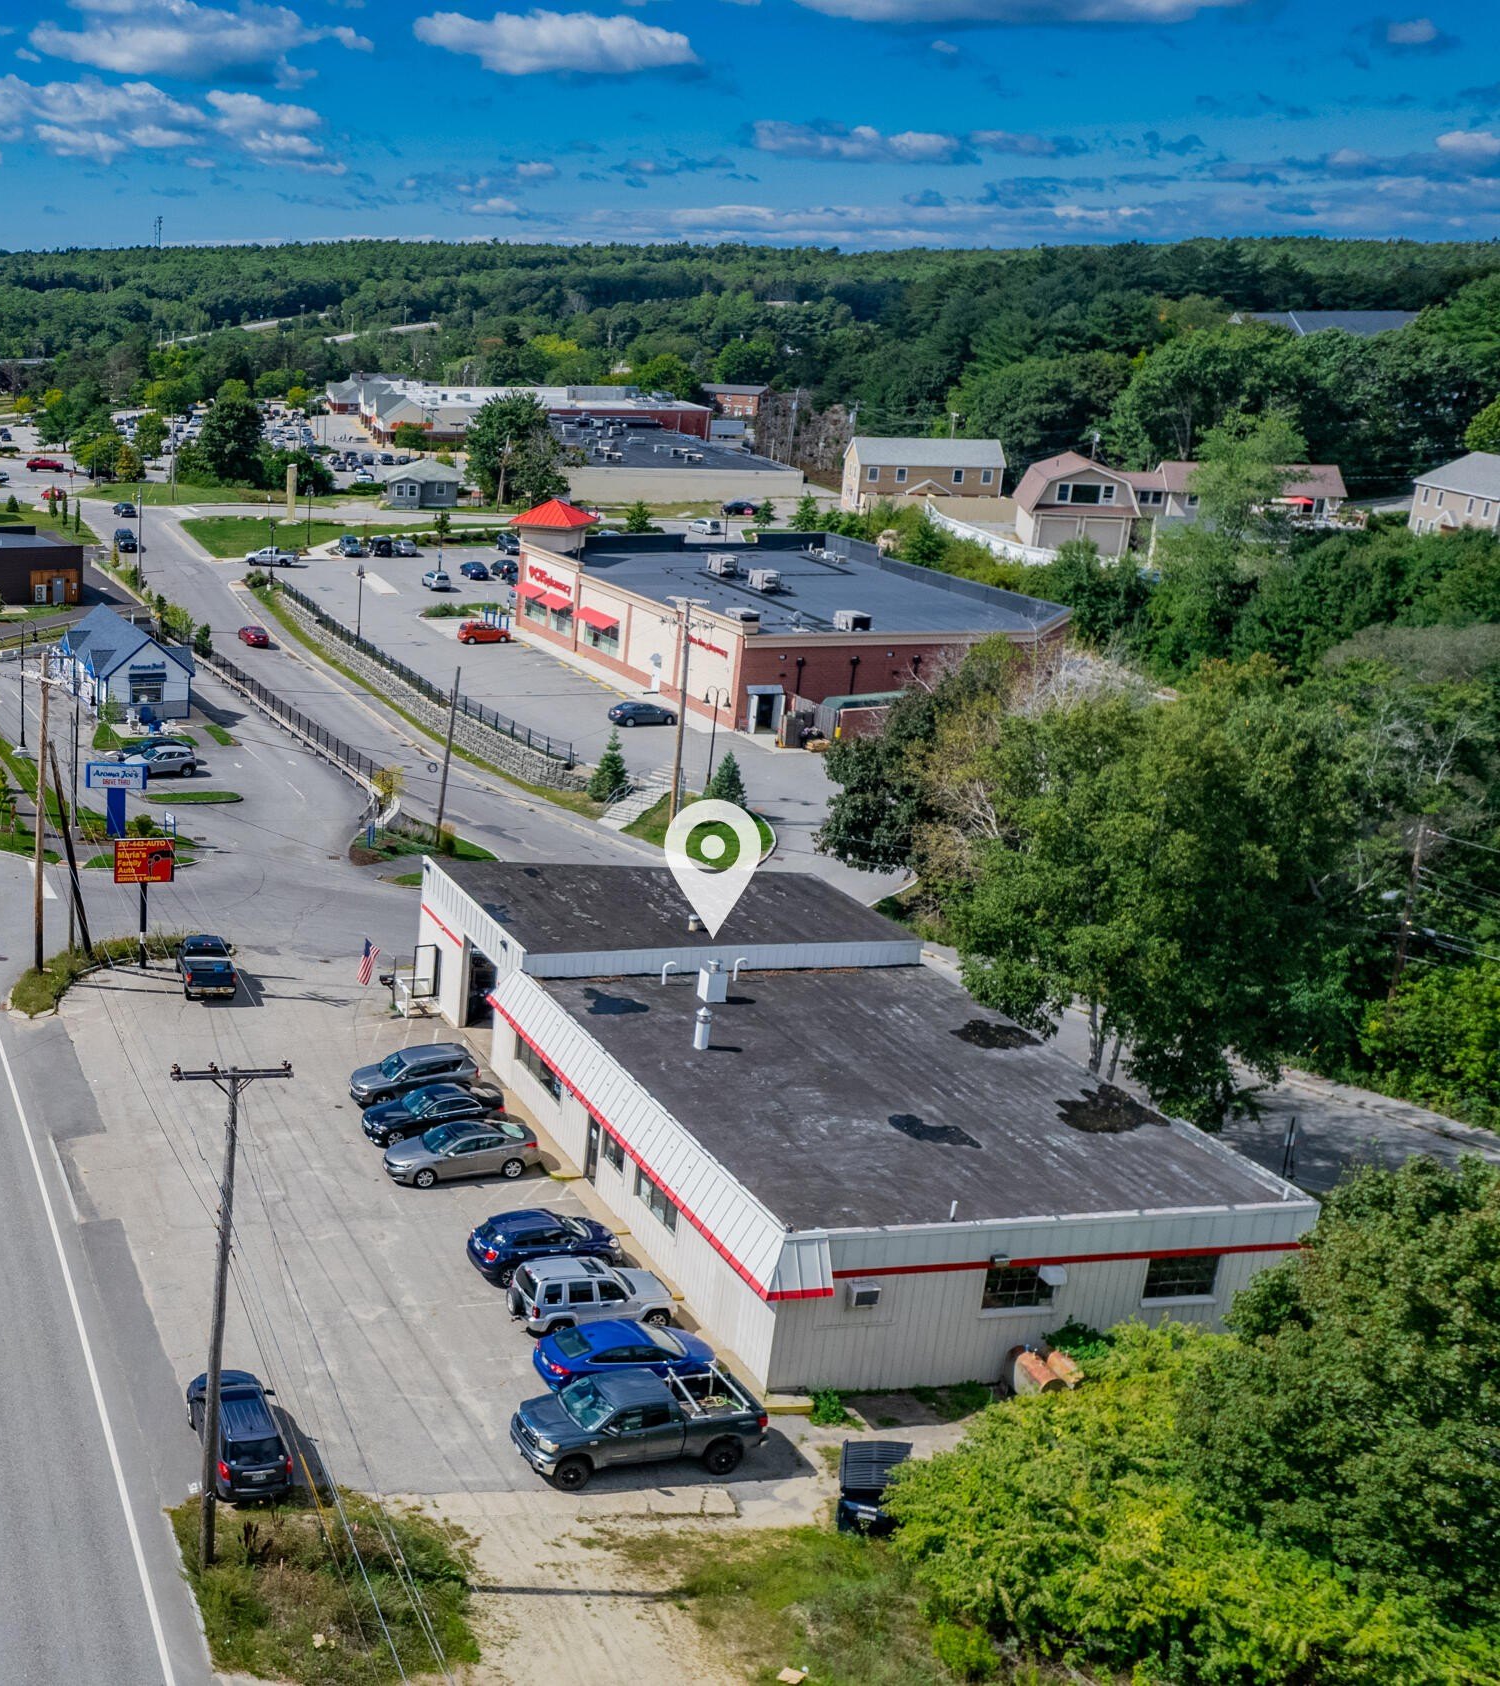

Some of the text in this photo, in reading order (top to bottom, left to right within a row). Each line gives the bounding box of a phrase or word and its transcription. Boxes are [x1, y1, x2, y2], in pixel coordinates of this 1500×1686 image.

[93, 769, 139, 778] Aroma Joe's
[103, 778, 117, 786] DRIVE
[117, 850, 147, 859] Maria's
[117, 860, 142, 868] Family
